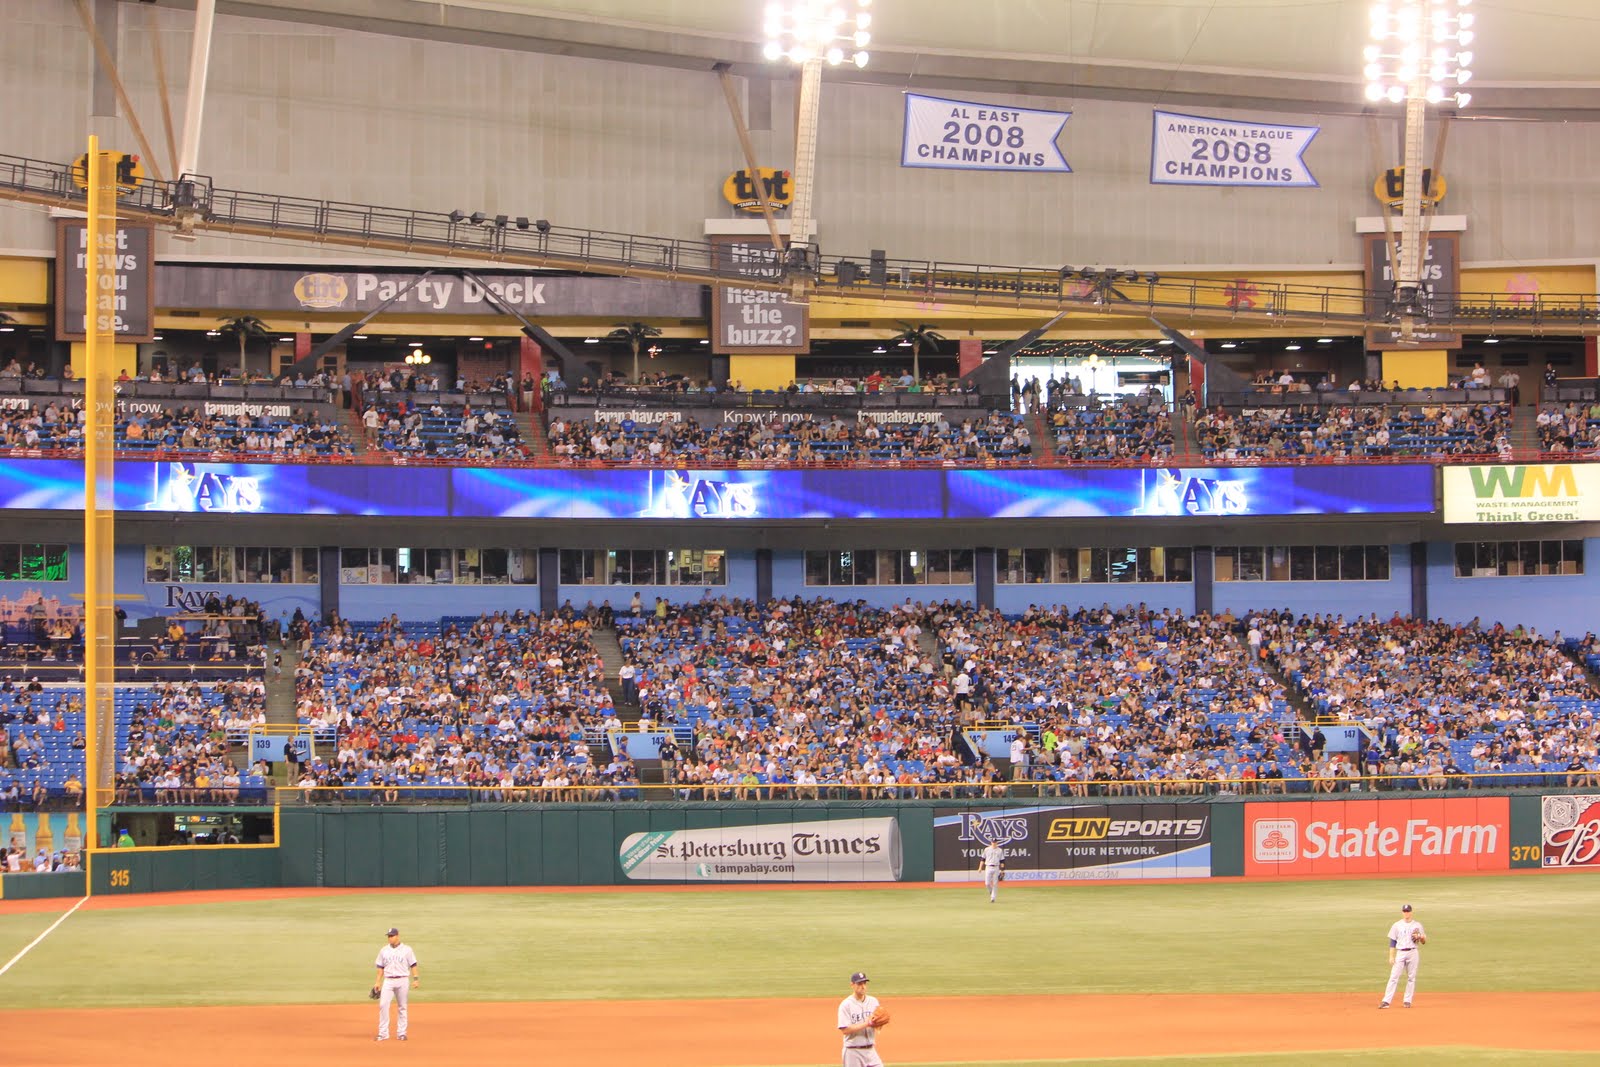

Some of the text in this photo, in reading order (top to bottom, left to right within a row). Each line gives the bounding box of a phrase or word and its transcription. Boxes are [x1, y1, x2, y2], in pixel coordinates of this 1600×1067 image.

[951, 108, 1020, 122] AL EAST
[942, 121, 1024, 148] 2008
[1168, 123, 1293, 140] AMERICAN LEAGUE
[917, 143, 1045, 166] CHAMPIONS
[1191, 138, 1271, 164] 2008
[1165, 160, 1292, 181] CHAMPIONS
[356, 274, 453, 309] Party
[464, 274, 546, 304] Deck
[741, 304, 782, 324] the
[727, 324, 796, 345] buzz?
[130, 402, 163, 413] now.
[1469, 465, 1579, 498] WM
[1476, 511, 1579, 522] Think Green.
[1344, 730, 1356, 739] 147
[256, 740, 271, 749] 139
[958, 812, 1028, 848] RAYS
[681, 839, 787, 862] Petersburg
[791, 833, 881, 856] Times
[962, 848, 1031, 858] YOU EAM.
[1066, 846, 1160, 856] YOUR NETWORK.
[1511, 846, 1540, 861] 370
[110, 869, 129, 887] 315
[714, 863, 795, 875] tampabay.com
